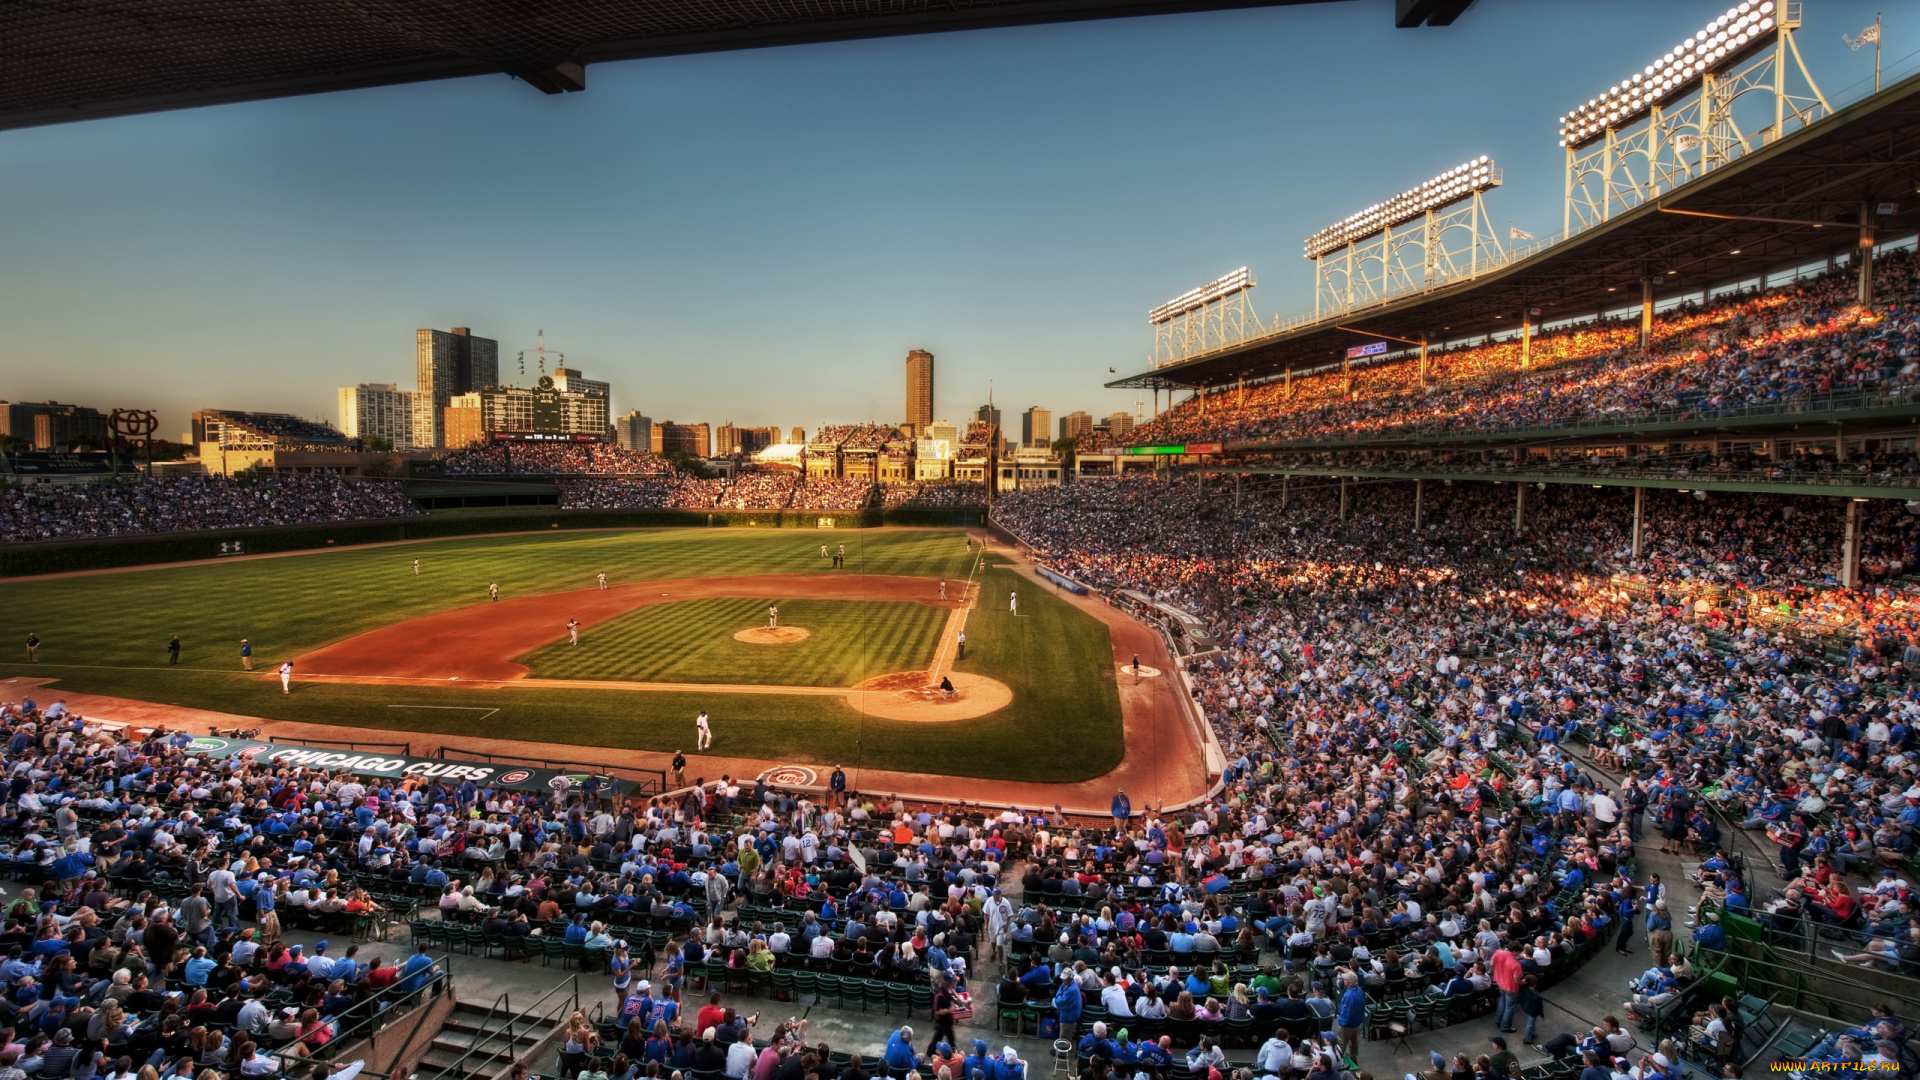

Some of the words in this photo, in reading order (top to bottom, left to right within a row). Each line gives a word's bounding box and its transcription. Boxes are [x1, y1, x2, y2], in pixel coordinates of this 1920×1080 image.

[269, 749, 405, 772] CHICAGO
[405, 762, 495, 780] CUBS
[553, 783, 561, 791] 26
[802, 838, 811, 849] 12
[1284, 895, 1298, 905] 25
[1312, 909, 1326, 919] 72
[625, 1001, 641, 1015] 29
[652, 1006, 666, 1020] 21
[1150, 1051, 1165, 1063] WOOD
